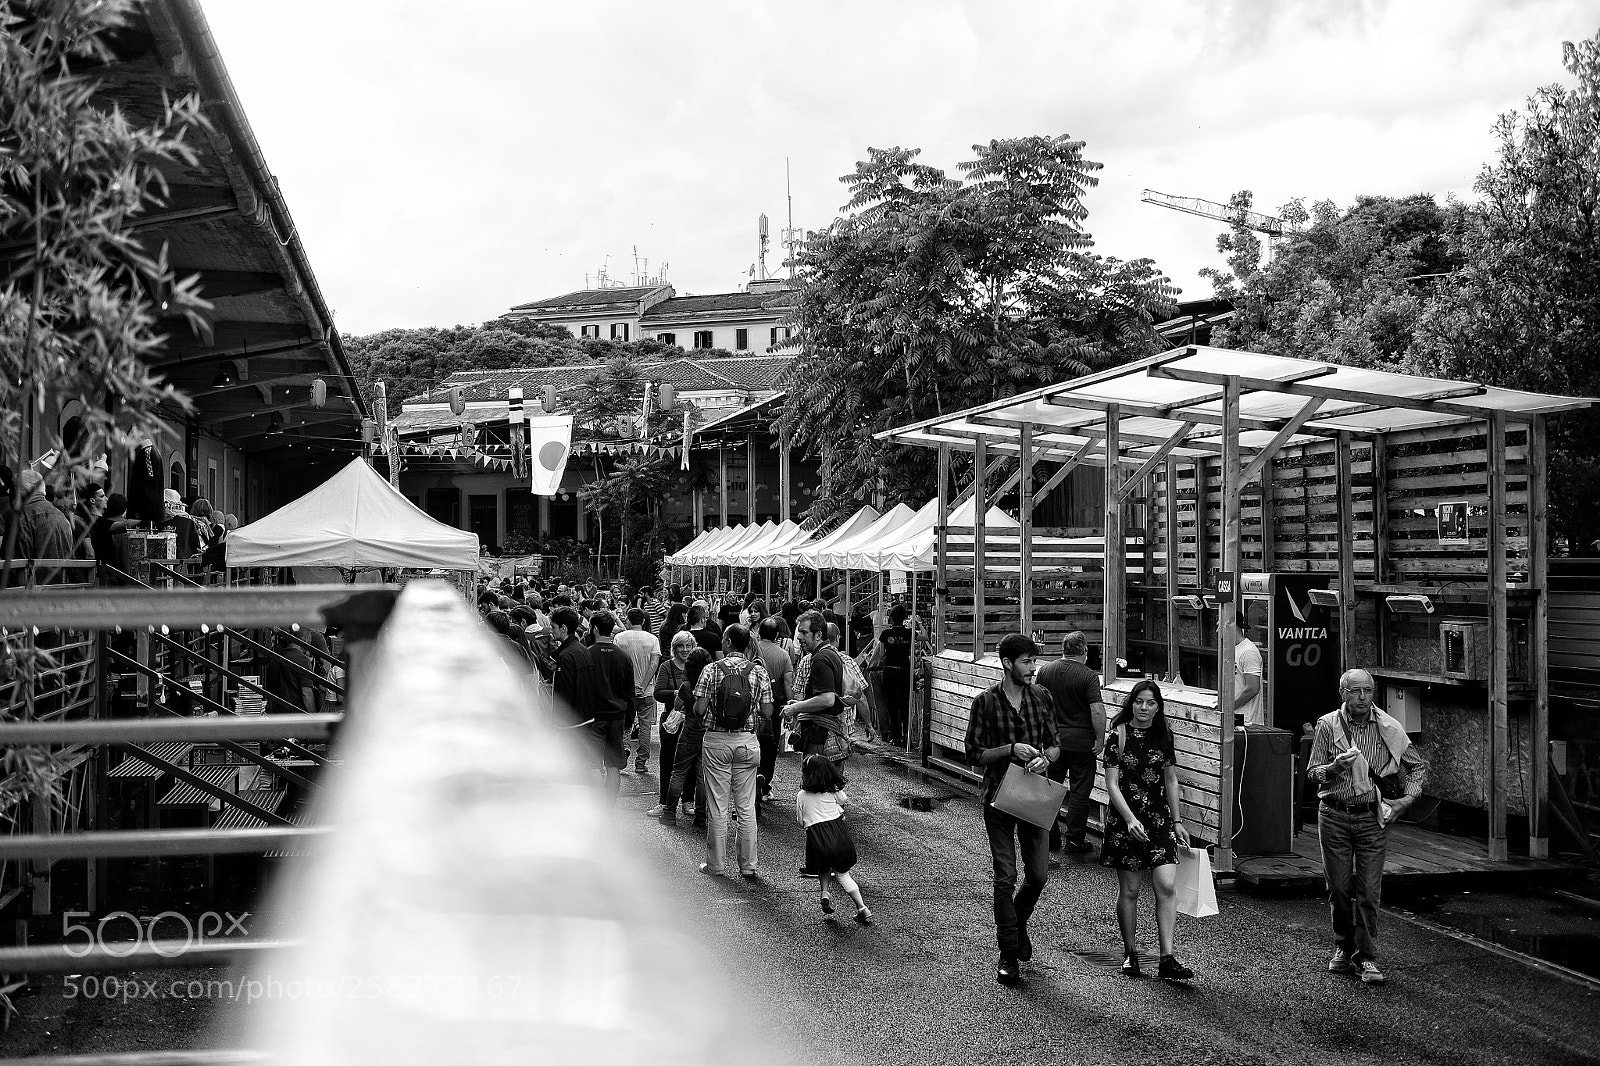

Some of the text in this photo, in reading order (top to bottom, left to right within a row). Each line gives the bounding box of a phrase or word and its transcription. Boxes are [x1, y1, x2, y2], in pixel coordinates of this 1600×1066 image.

[1218, 580, 1232, 592] CASSA
[1278, 628, 1328, 639] VANTEA
[1286, 643, 1322, 667] GO
